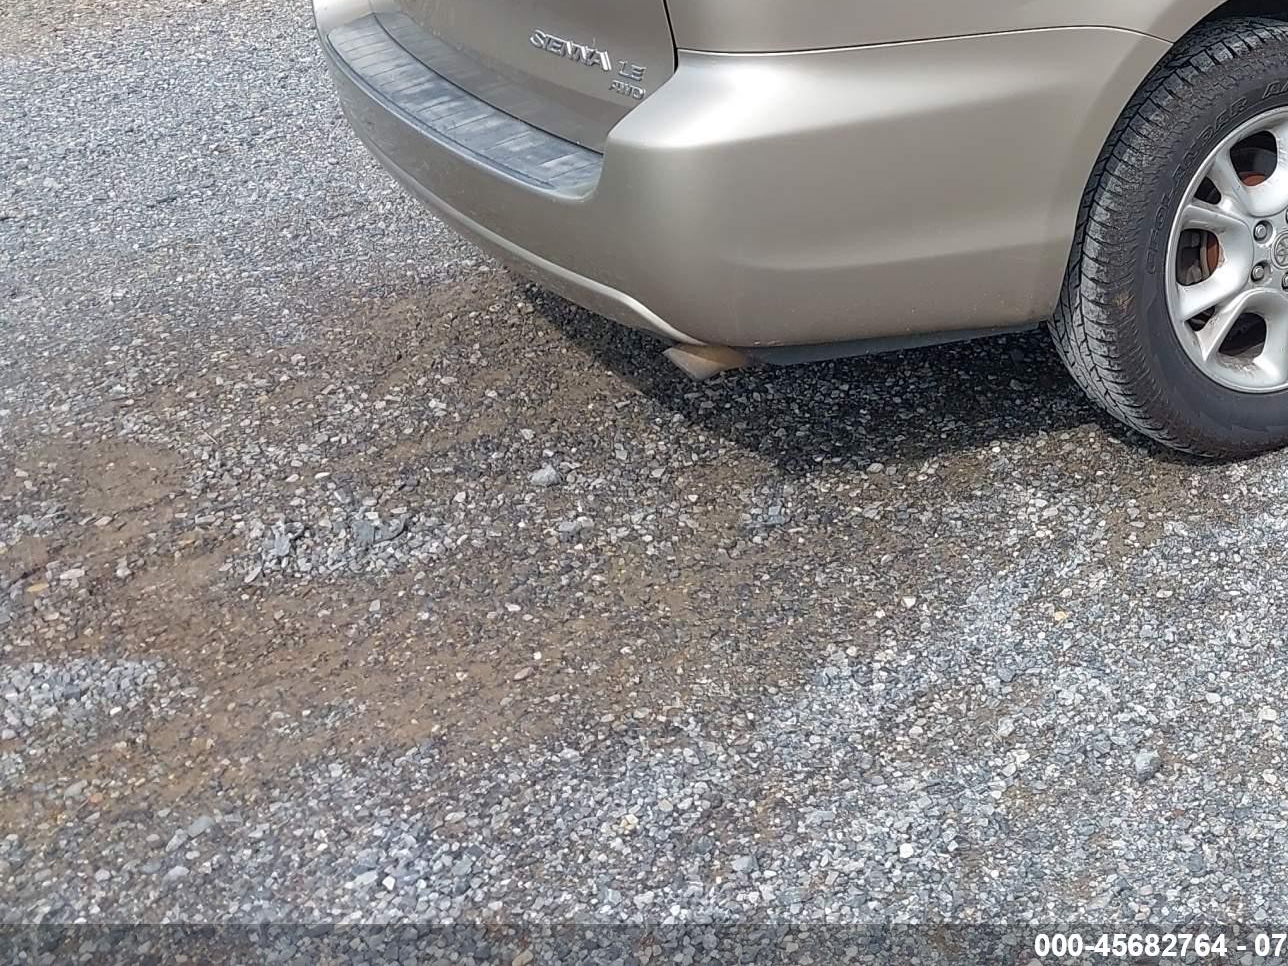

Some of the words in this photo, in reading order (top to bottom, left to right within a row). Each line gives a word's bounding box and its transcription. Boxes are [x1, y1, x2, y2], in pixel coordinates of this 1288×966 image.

[530, 29, 612, 71] SIENNA
[617, 60, 646, 81] LE
[609, 79, 646, 100] AWD
